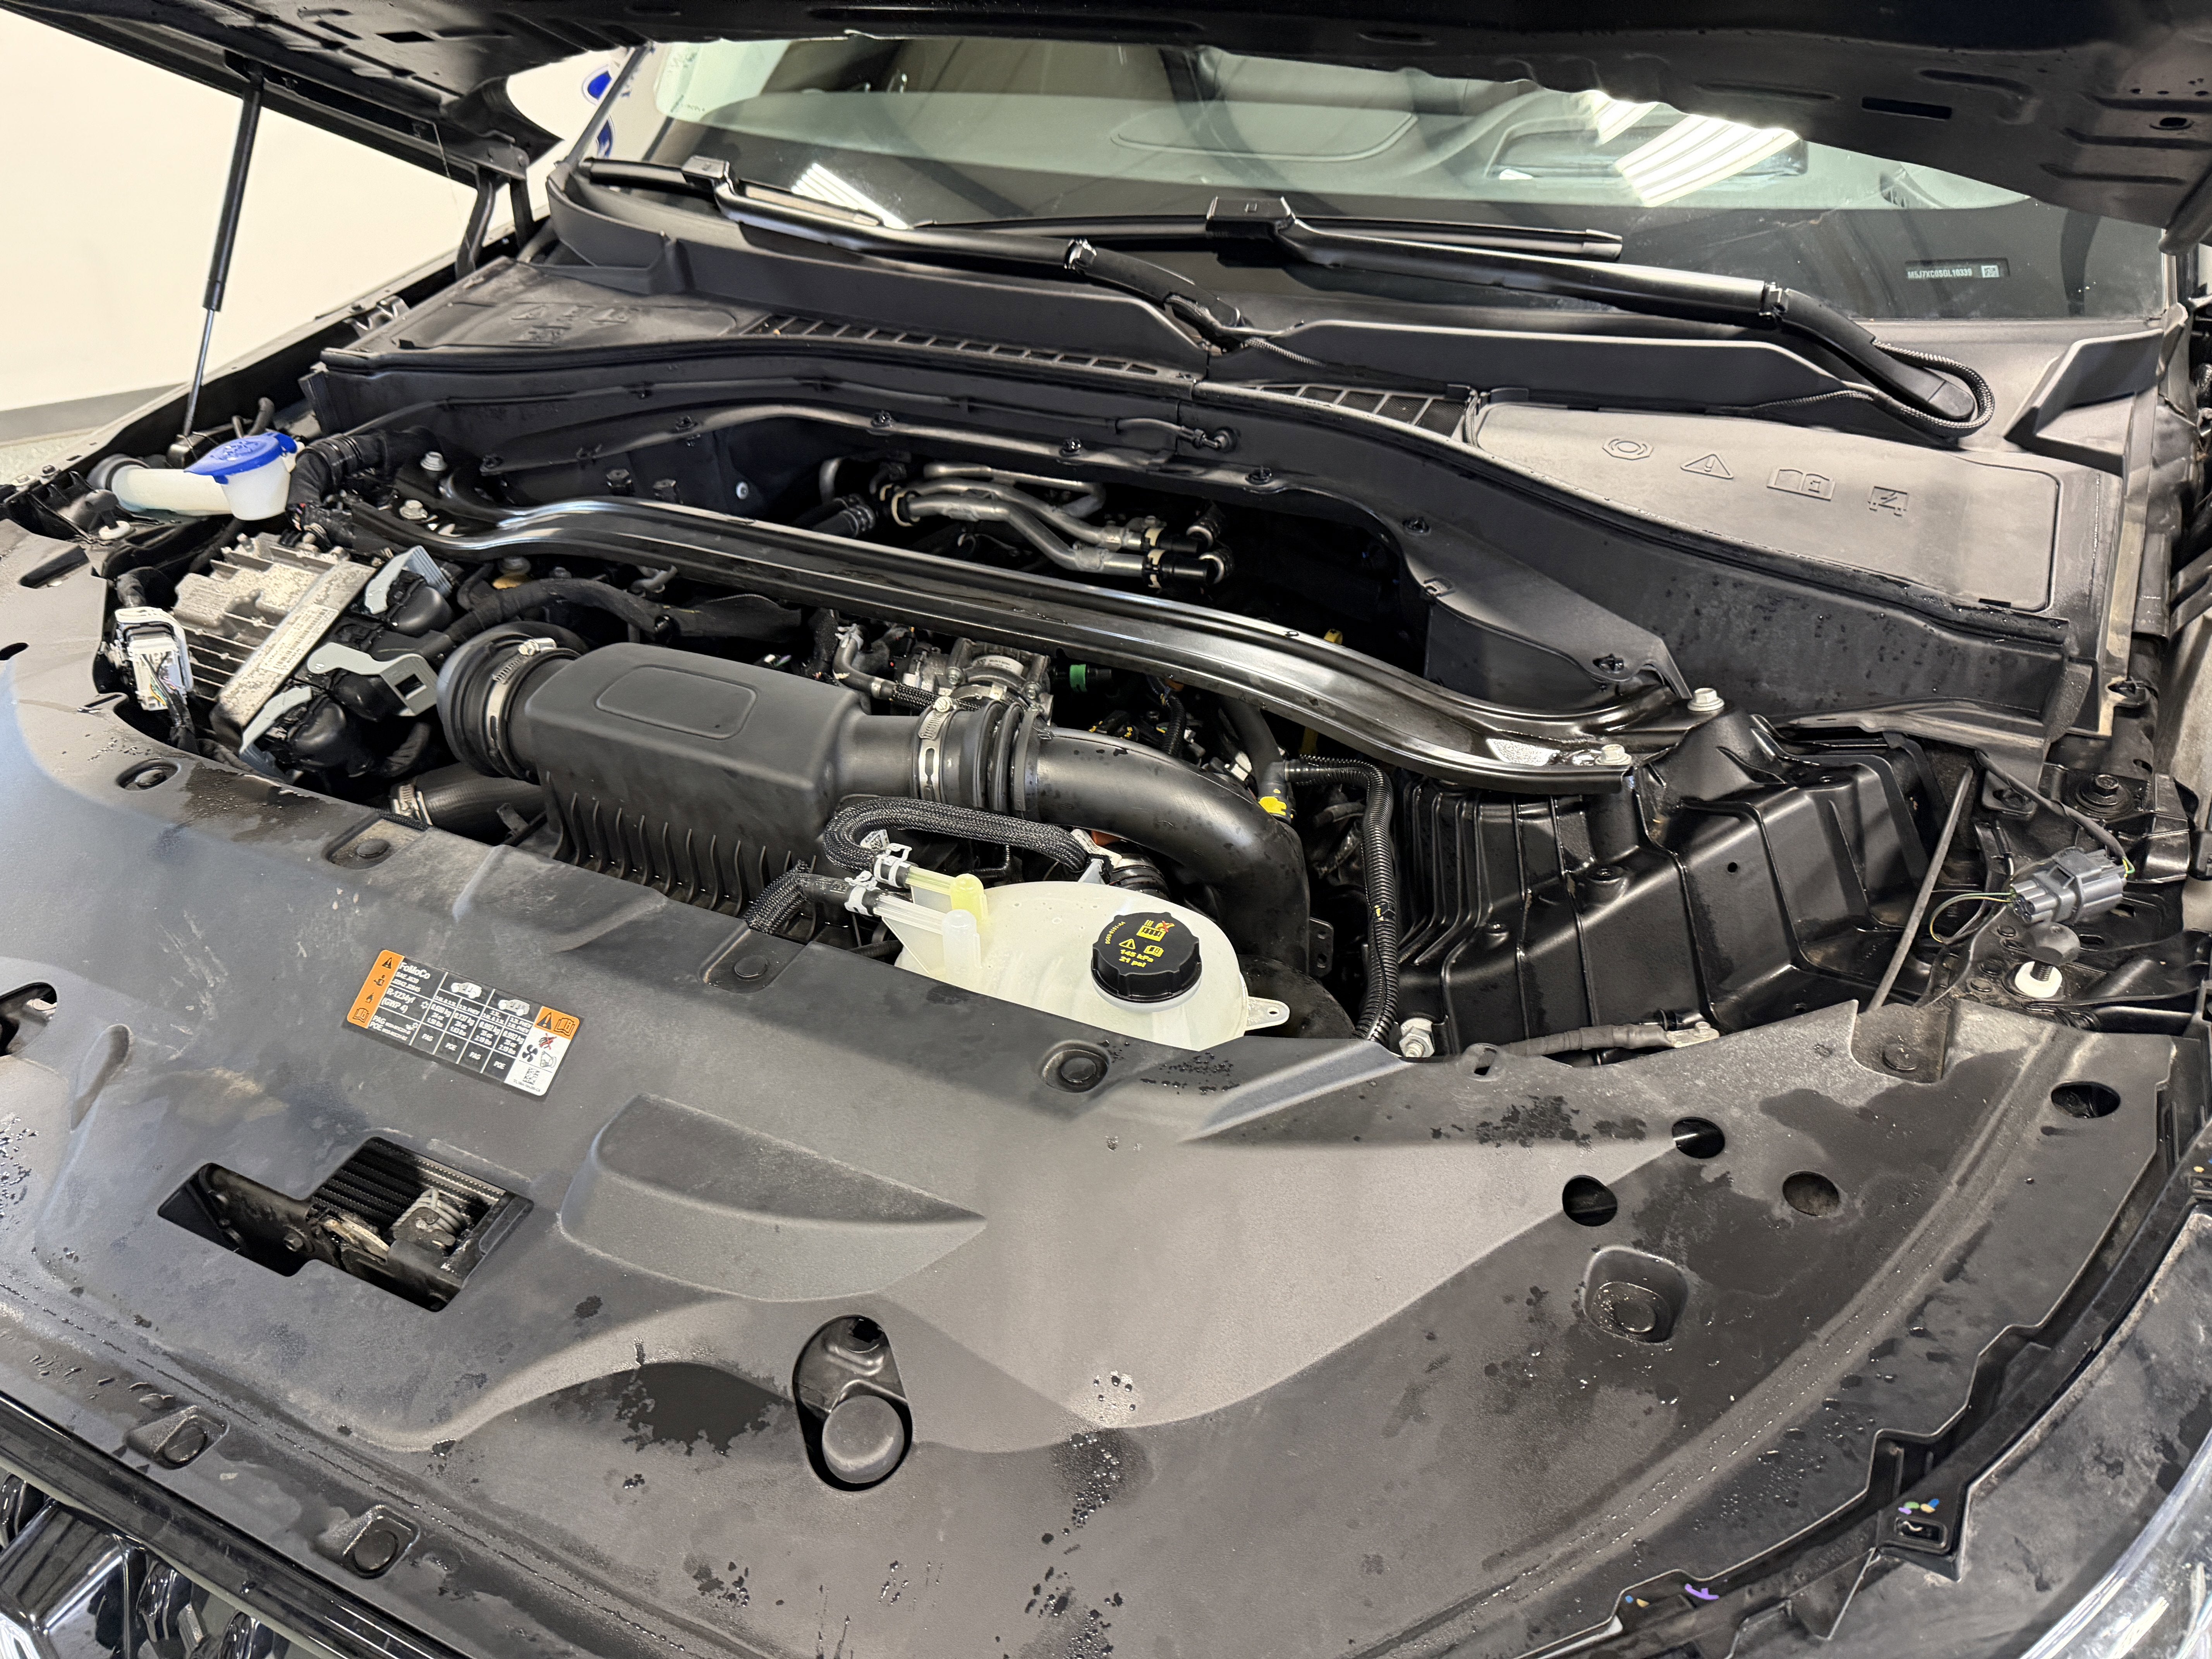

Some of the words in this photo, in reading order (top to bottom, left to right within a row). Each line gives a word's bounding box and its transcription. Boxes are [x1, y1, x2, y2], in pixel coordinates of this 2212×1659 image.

[1120, 949, 1137, 957] 145
[1137, 953, 1154, 963] kPa
[398, 962, 431, 979] FoMoCo
[395, 972, 408, 980] SAE
[386, 988, 416, 1004] R-1234yf
[381, 998, 401, 1008] (GWP
[400, 1005, 409, 1014] 4)
[444, 1009, 452, 1018] kg
[372, 1015, 386, 1025] PAG
[467, 1017, 476, 1026] kg
[369, 1021, 384, 1031] POE
[493, 1026, 501, 1036] kg
[422, 1034, 434, 1042] PAG
[516, 1036, 525, 1045] kg
[445, 1042, 457, 1051] POE
[469, 1052, 481, 1060] PAG
[493, 1061, 506, 1070] POE
